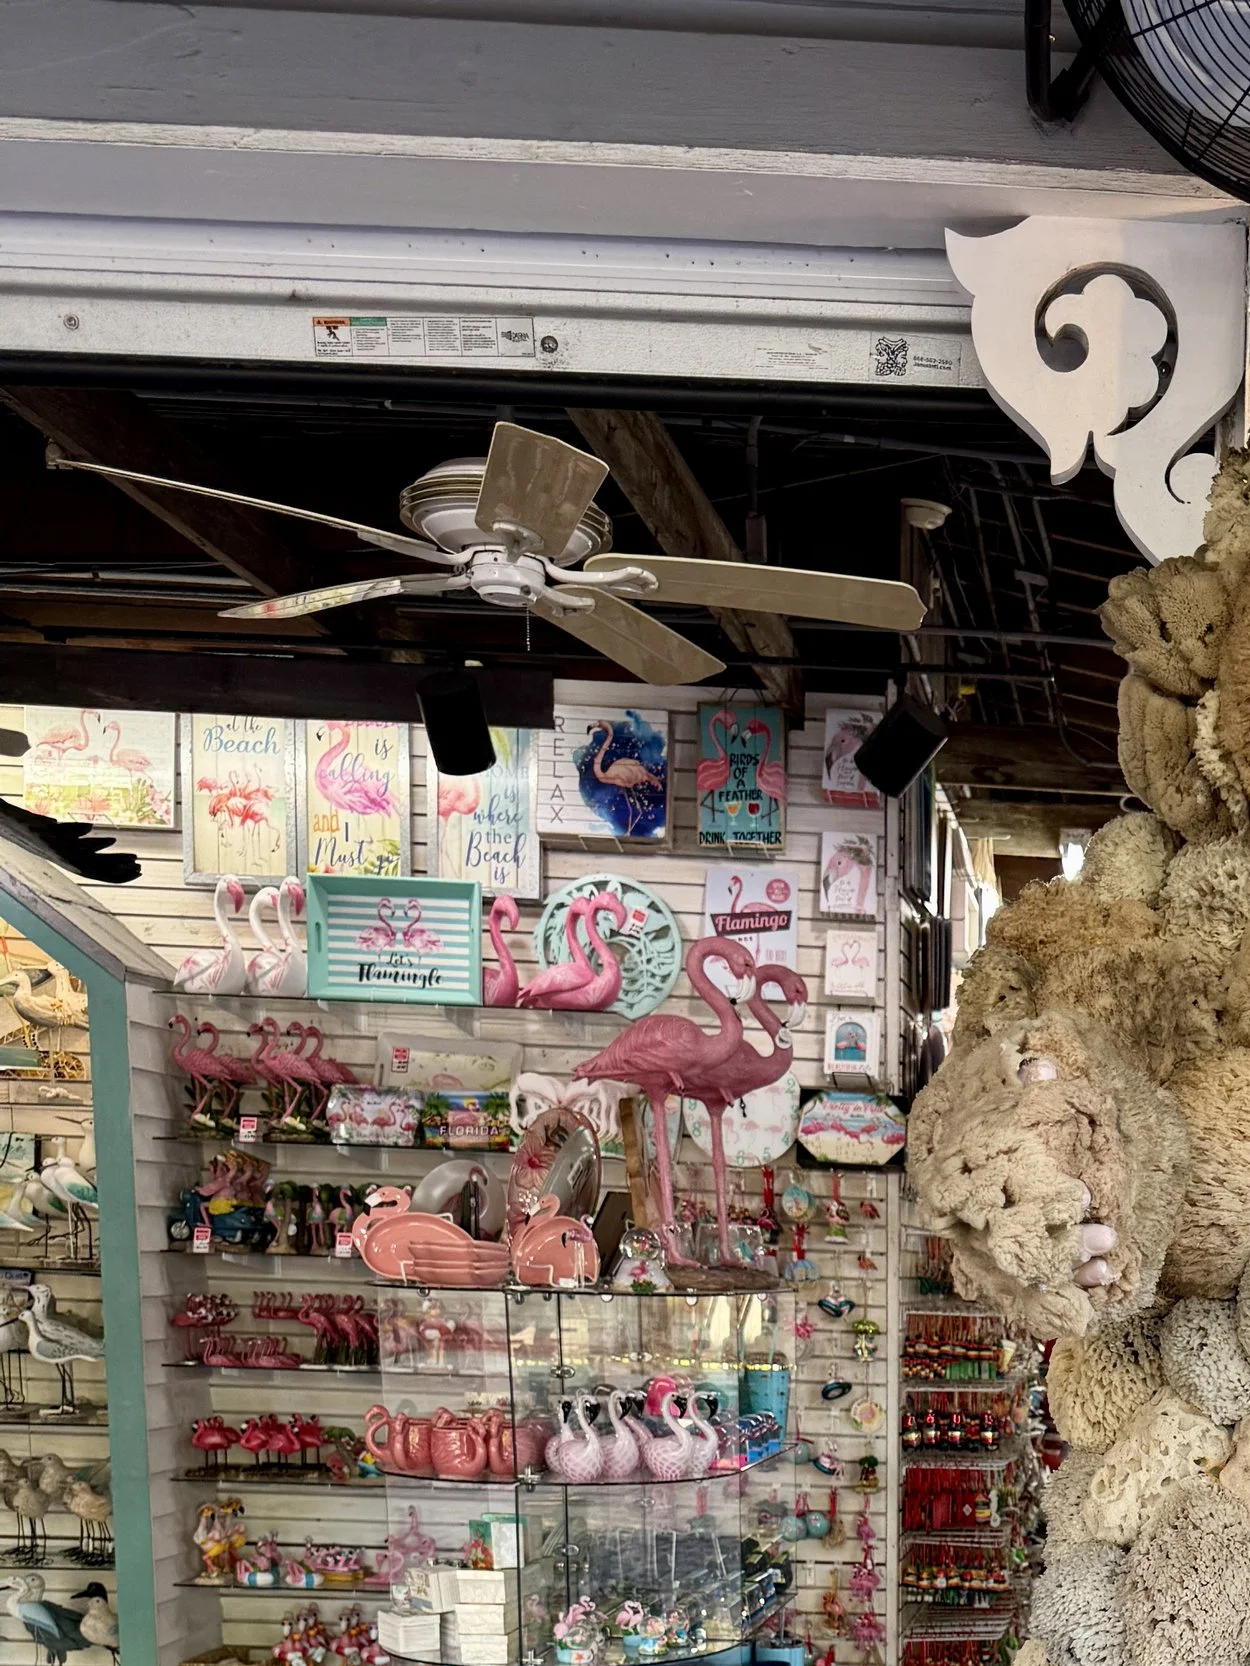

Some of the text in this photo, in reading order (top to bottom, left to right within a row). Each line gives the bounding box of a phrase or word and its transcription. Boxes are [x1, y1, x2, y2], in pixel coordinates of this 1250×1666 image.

[203, 725, 281, 754] Beach
[374, 738, 394, 760] is
[729, 753, 760, 767] BIRDS
[318, 753, 395, 798] calling
[550, 716, 565, 824] RELAX
[733, 767, 748, 780] OF
[504, 783, 518, 802] is
[736, 779, 746, 789] A
[718, 789, 763, 802] FEATHER
[473, 794, 525, 825] where
[313, 809, 341, 833] and
[486, 828, 513, 844] the
[699, 831, 782, 845] DRINK TOGETHER
[314, 836, 374, 868] Must
[465, 831, 527, 867] Beach
[494, 867, 510, 885] is
[714, 913, 789, 932] Flamingo
[385, 951, 415, 968] Let's
[357, 962, 443, 990] Flamingle
[439, 1124, 499, 1137] FLORIDA
